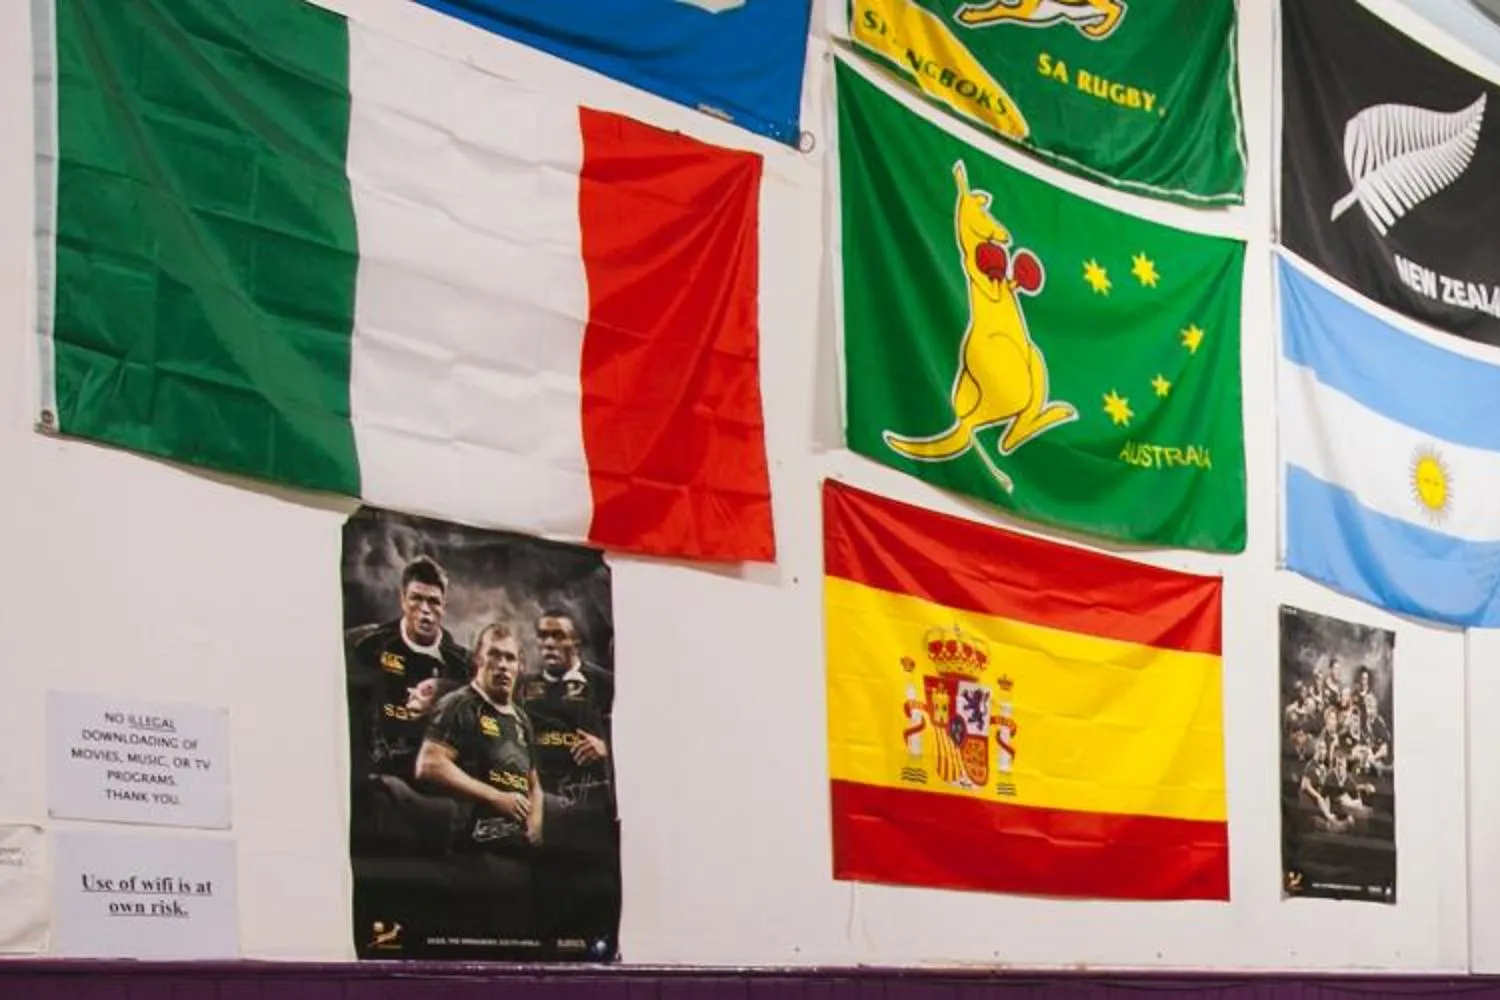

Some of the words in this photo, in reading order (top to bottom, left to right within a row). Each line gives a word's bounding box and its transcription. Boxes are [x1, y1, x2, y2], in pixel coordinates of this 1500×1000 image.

[1038, 53, 1069, 85] SA
[1077, 68, 1156, 113] RUGBY
[1394, 253, 1437, 300] NEW
[104, 712, 124, 724] NO
[128, 714, 176, 731] ILLEGAL
[81, 729, 179, 749] DOWNLOADING
[183, 739, 198, 750] OF
[173, 757, 191, 768] OR
[195, 758, 211, 771] TV
[105, 788, 149, 802] THANK
[82, 873, 113, 891] Use
[119, 875, 136, 891] of
[141, 876, 174, 893] wifi
[178, 876, 191, 893] is
[196, 881, 212, 894] at
[109, 902, 145, 914] own
[151, 900, 189, 917] risk.
